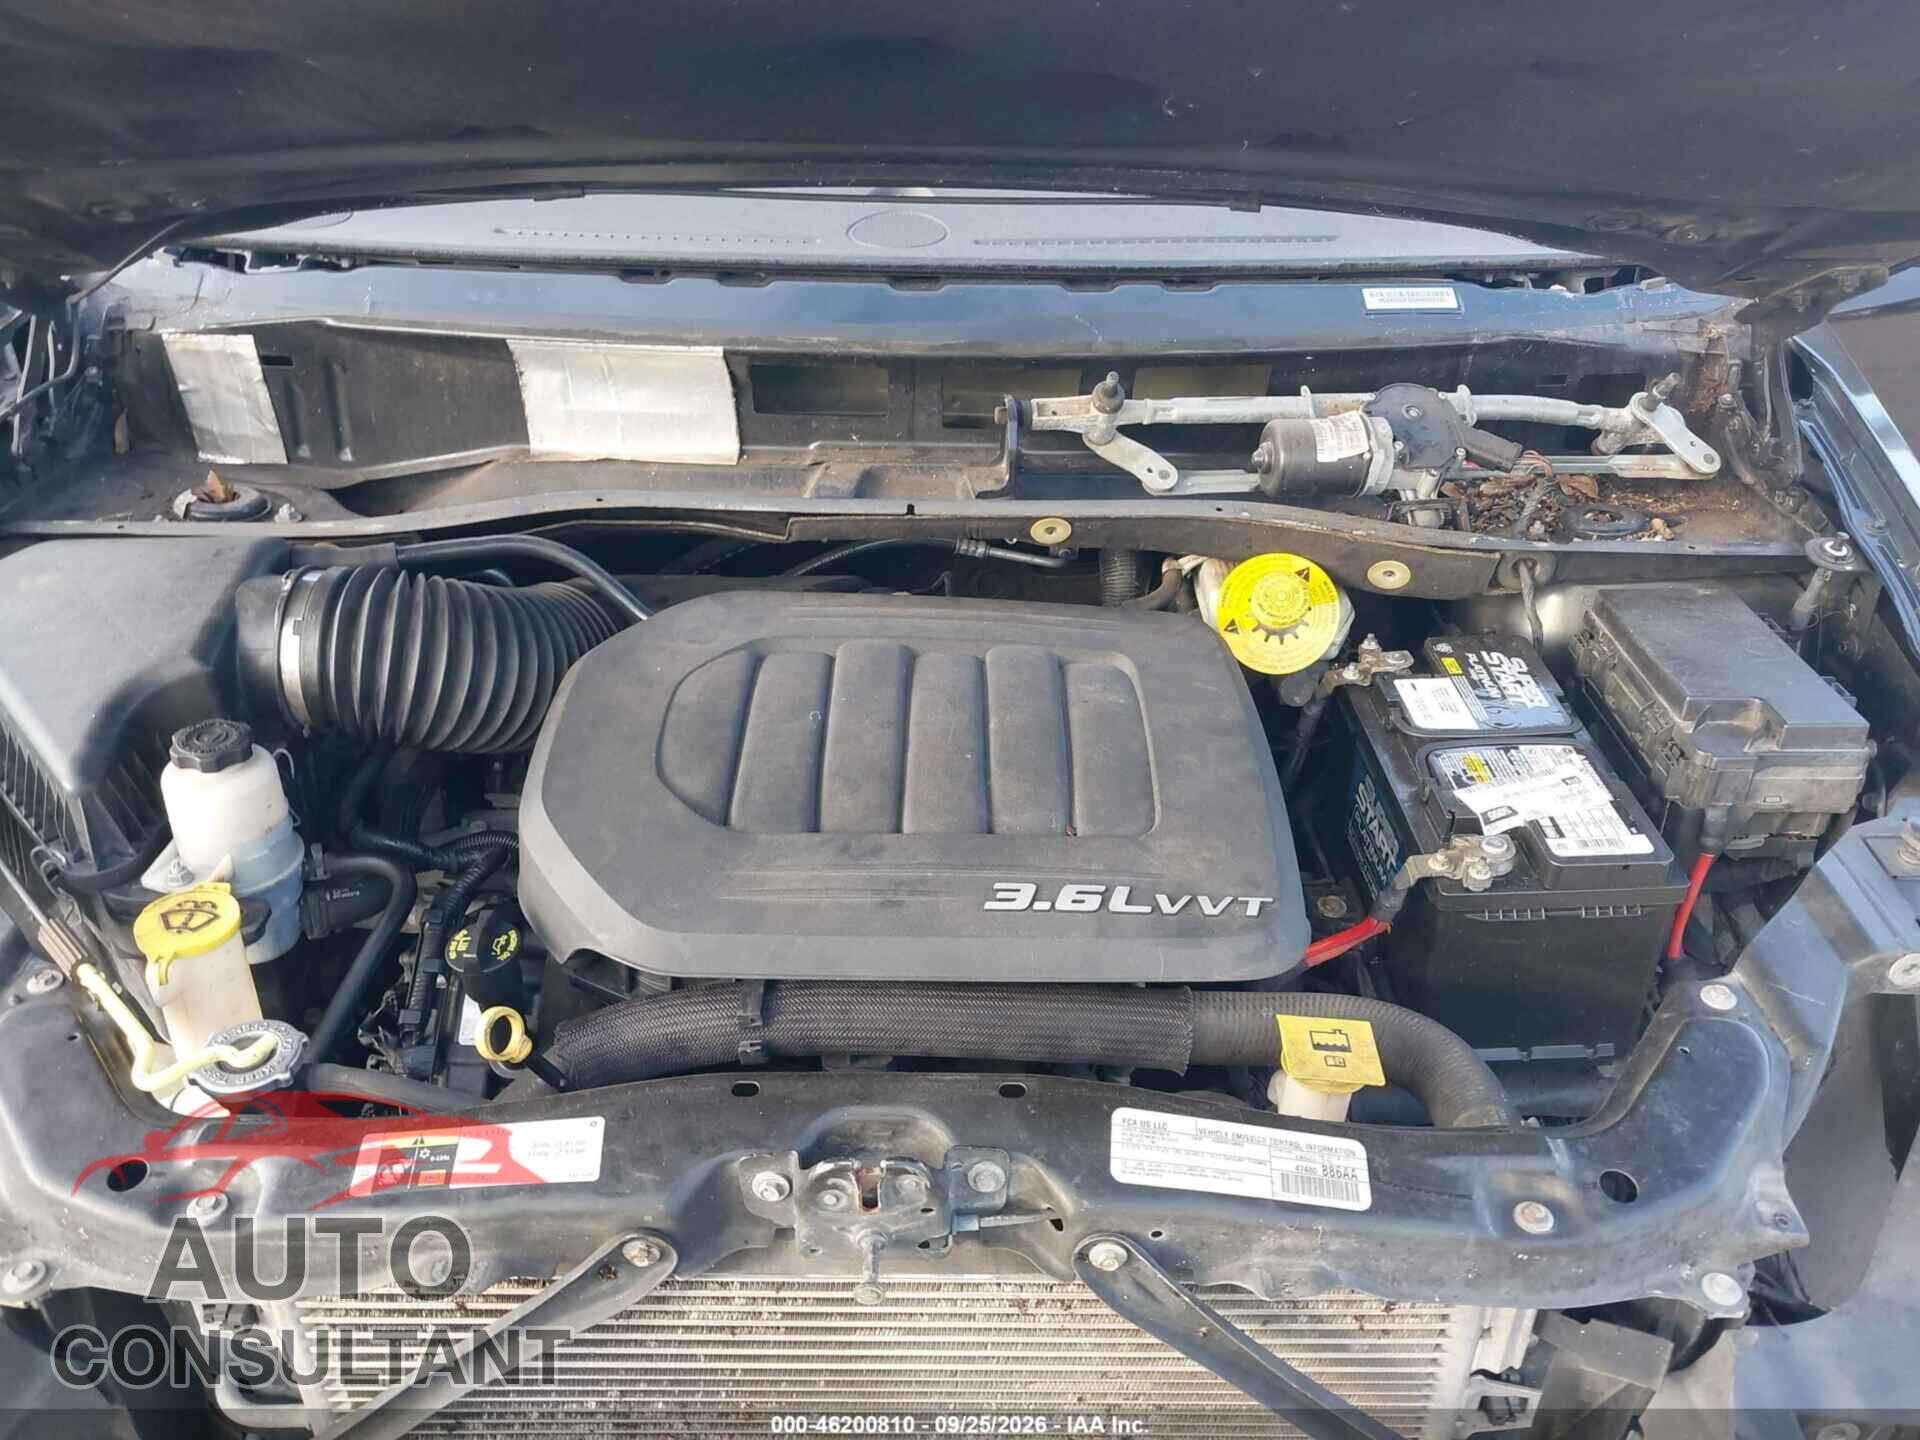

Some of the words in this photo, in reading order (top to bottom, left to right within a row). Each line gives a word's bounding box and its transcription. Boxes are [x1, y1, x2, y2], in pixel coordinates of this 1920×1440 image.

[984, 882, 1153, 914] 3.6L
[1154, 894, 1275, 917] VVT
[1155, 1121, 1168, 1130] LLC
